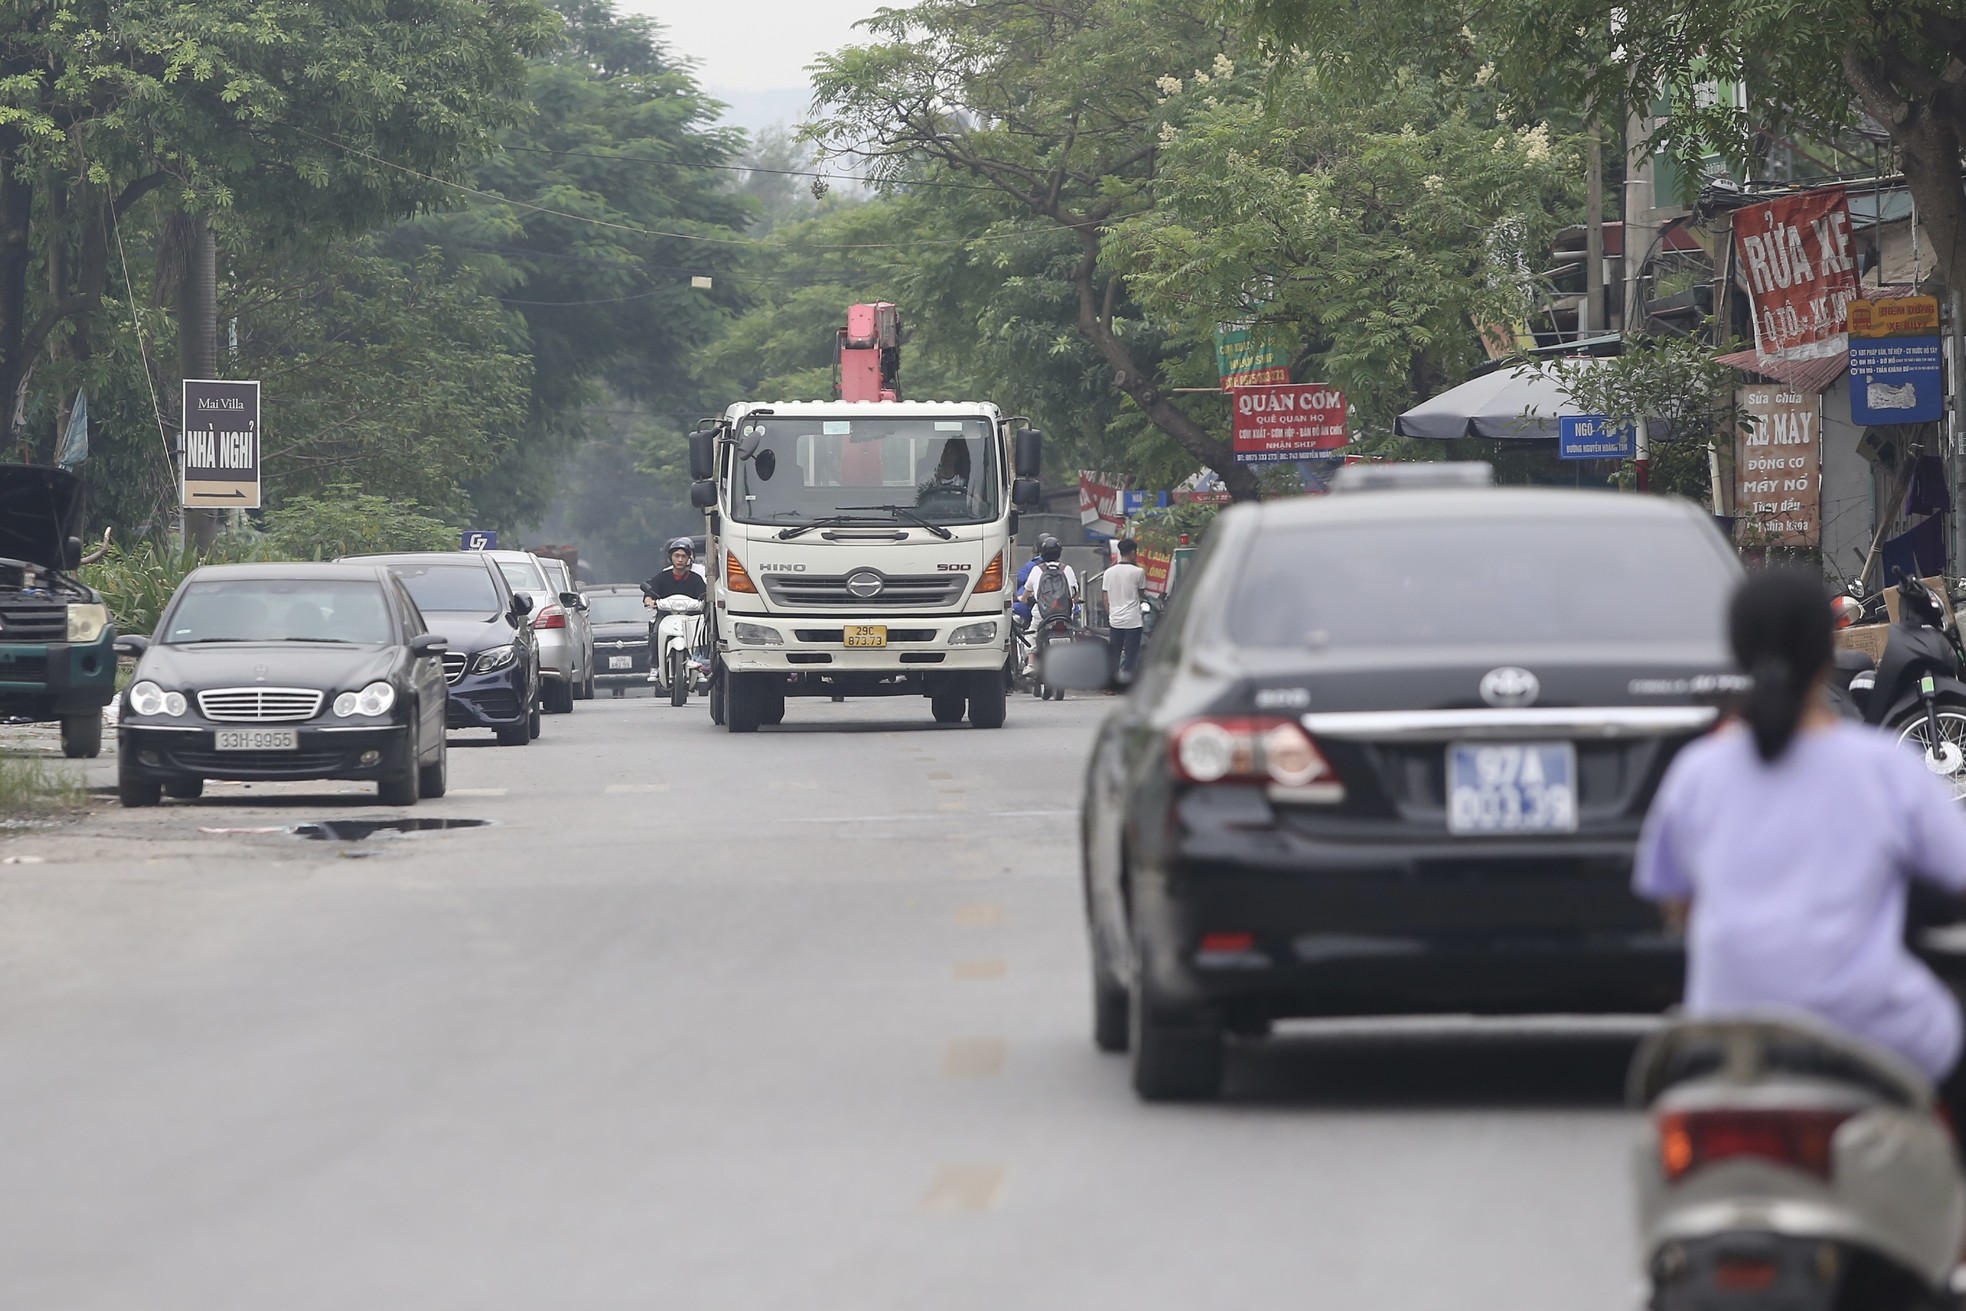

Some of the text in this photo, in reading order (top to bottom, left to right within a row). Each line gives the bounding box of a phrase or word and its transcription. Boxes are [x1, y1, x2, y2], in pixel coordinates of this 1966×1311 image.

[1743, 210, 1854, 294] RỬA XE
[198, 398, 244, 409] Mai Villa
[1240, 390, 1341, 415] QUÁN CƠM
[1748, 391, 1769, 405] Sửa
[1256, 414, 1324, 424] QUÊ QUAN HỌ
[1575, 420, 1593, 437] NGÕ
[1746, 408, 1812, 446] XE MÁY
[187, 420, 254, 469] NHÀ NGHỈ
[1266, 440, 1317, 450] NHẬN SHIP
[1748, 455, 1805, 473] ĐỘNG CƠ
[1744, 473, 1809, 493] MÁY NỔ
[759, 563, 806, 572] HINO
[937, 563, 971, 571] 500
[856, 626, 874, 636] 29C
[848, 636, 882, 645] 873.73
[220, 732, 292, 748] 33H-9955
